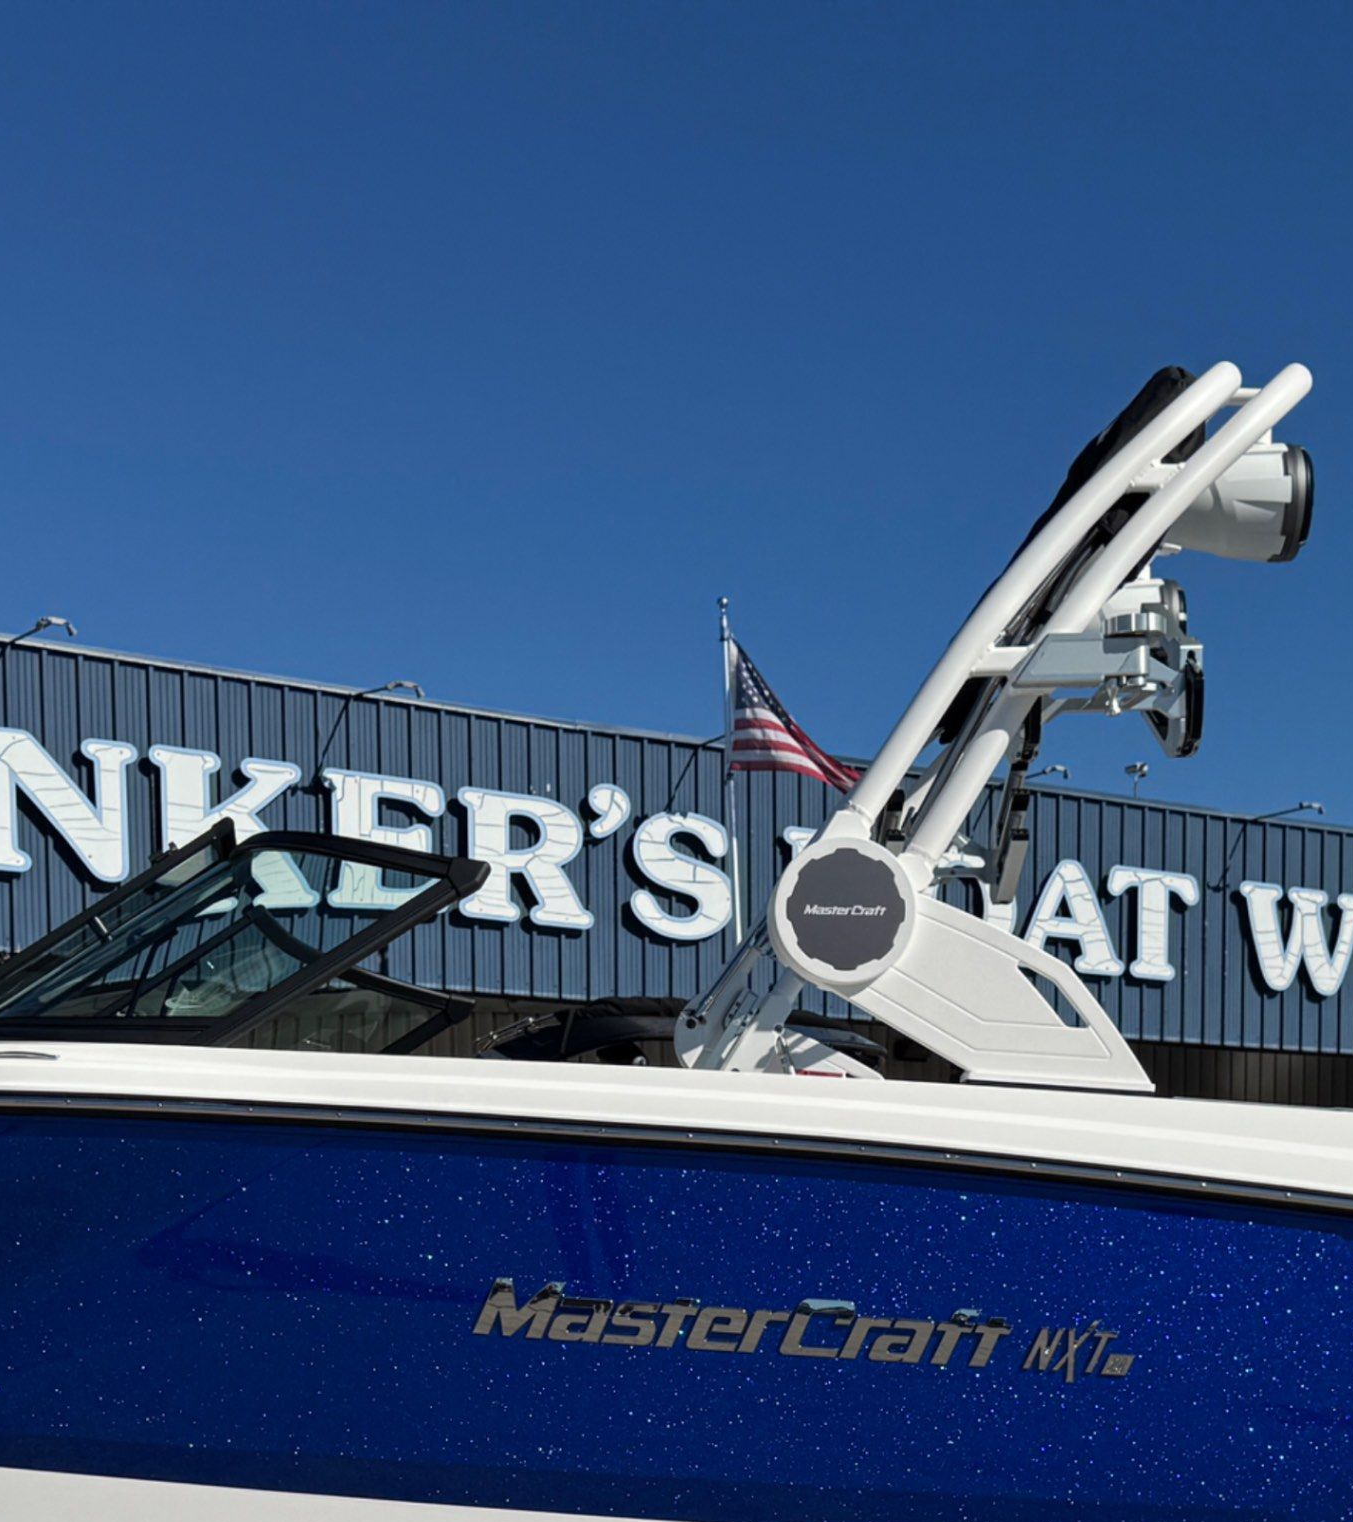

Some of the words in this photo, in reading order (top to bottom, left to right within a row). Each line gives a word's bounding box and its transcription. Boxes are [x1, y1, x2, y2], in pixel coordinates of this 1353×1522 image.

[803, 904, 887, 917] MasterCraft
[472, 1277, 1014, 1367] MasterCraft
[1022, 1319, 1119, 1383] NXT
